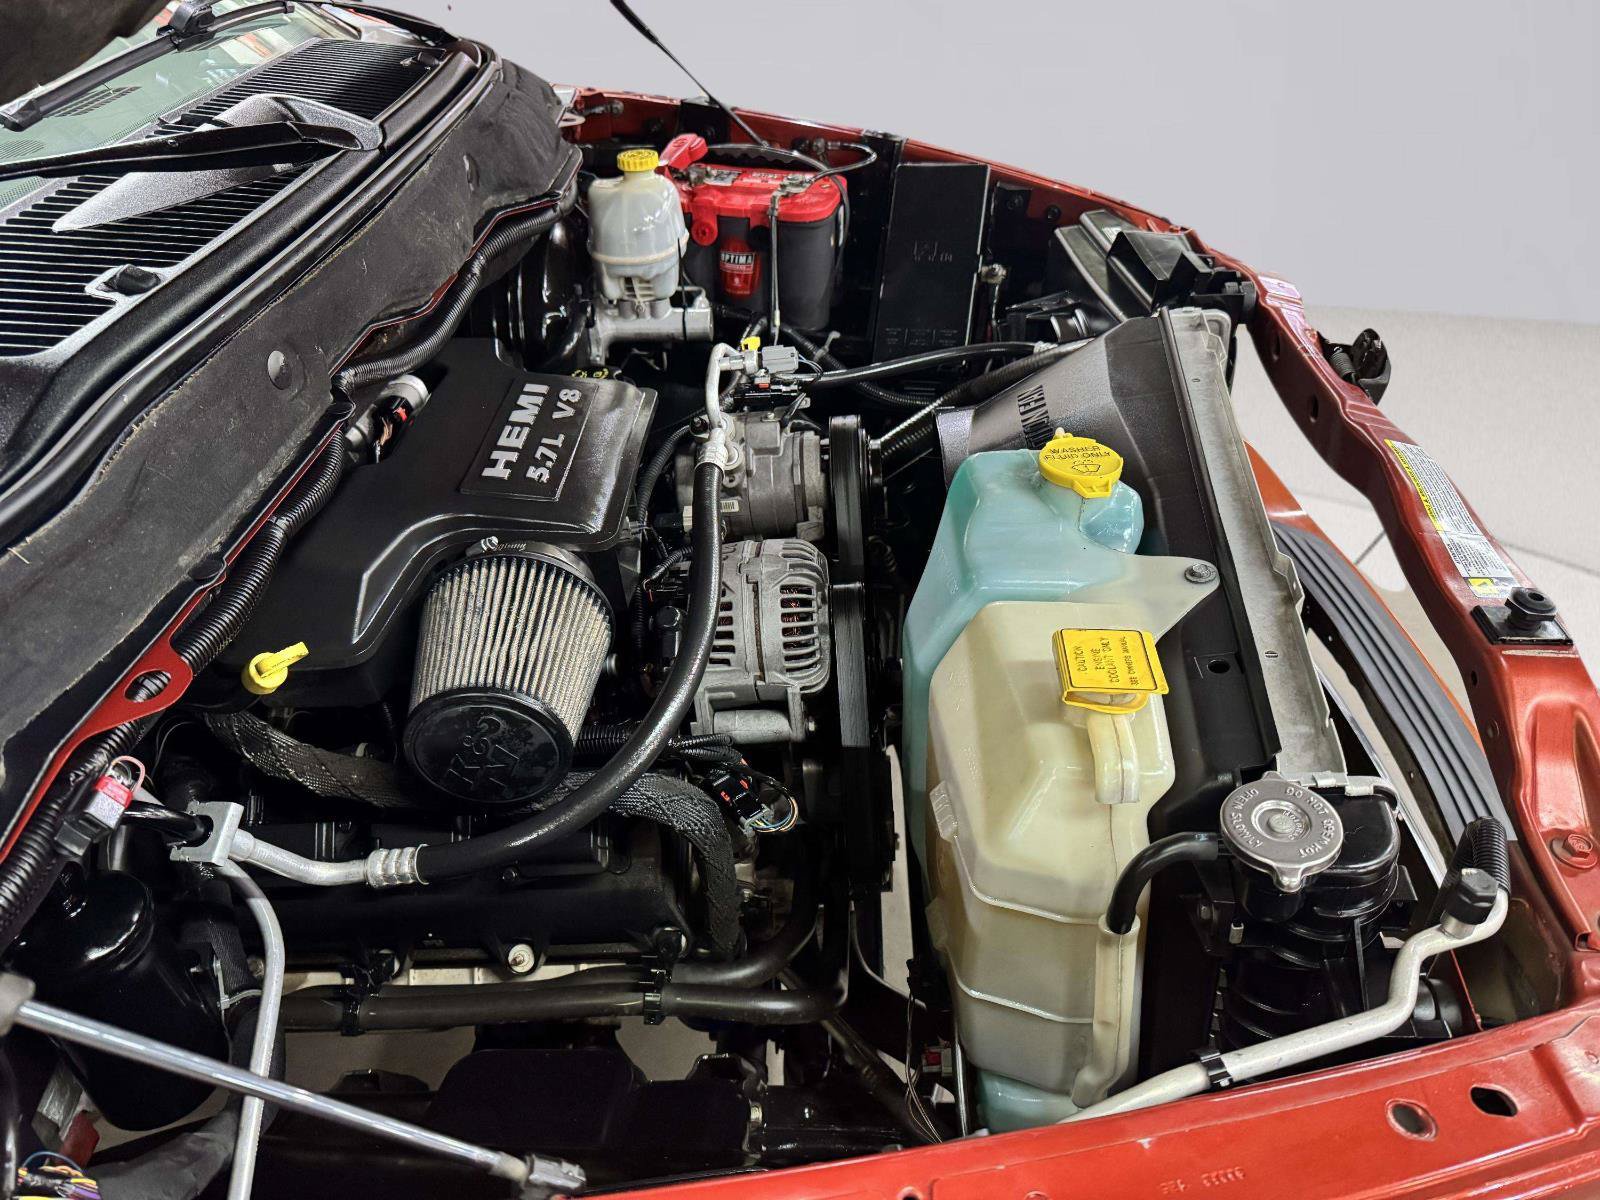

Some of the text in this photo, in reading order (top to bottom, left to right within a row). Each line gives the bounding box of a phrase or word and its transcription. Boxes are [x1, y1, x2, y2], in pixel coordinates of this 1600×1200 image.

[481, 383, 551, 481] HEMI
[525, 388, 582, 484] 5.7L V8
[1049, 446, 1101, 454] WASHER
[1081, 451, 1112, 459] ONLY
[1073, 645, 1088, 673] CAUTION
[1100, 637, 1120, 683] COOLANT ONLY
[1233, 787, 1260, 811] OPEN
[1285, 786, 1303, 799] DO
[1306, 796, 1329, 815] NOT
